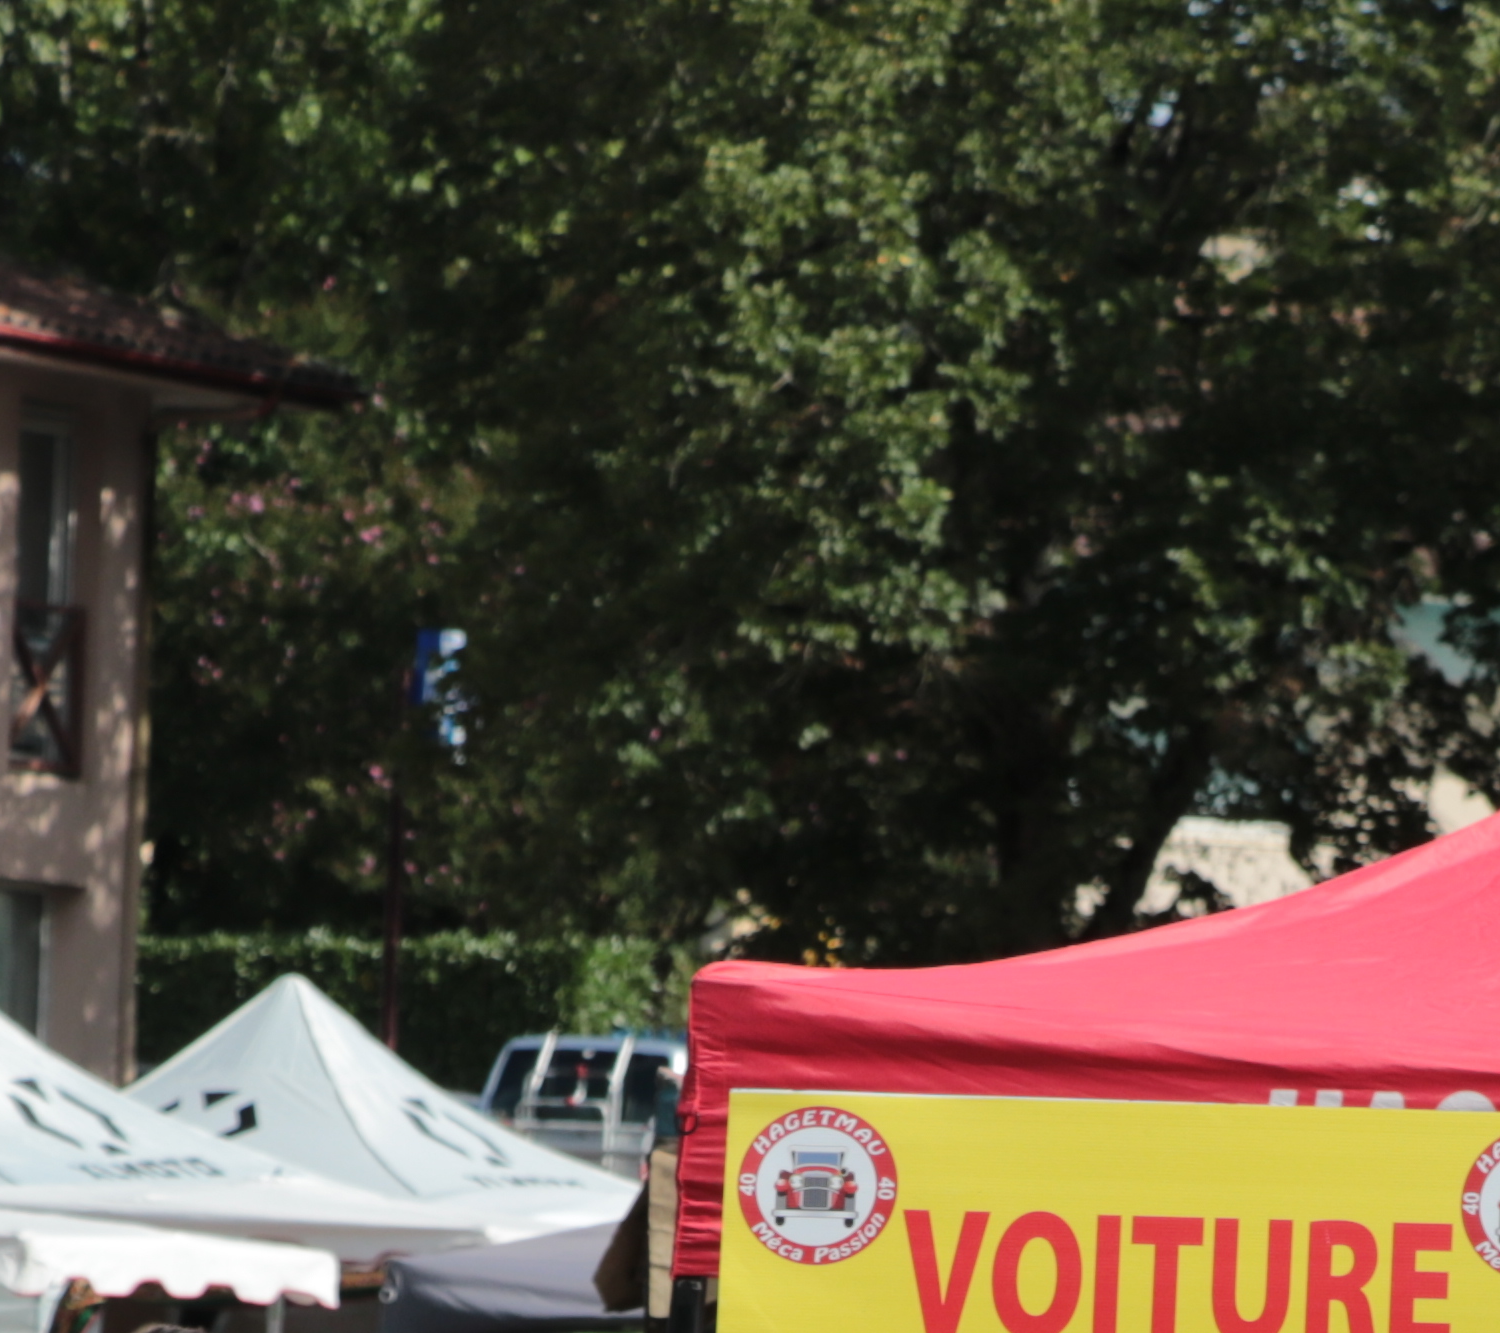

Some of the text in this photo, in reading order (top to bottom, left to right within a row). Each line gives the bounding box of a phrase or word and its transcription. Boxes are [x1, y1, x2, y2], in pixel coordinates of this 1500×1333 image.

[752, 1110, 886, 1155] HAGETMAU
[739, 1173, 757, 1196] 40
[877, 1177, 896, 1200] 40
[1462, 1192, 1480, 1215] 40
[813, 1213, 886, 1263] Passion
